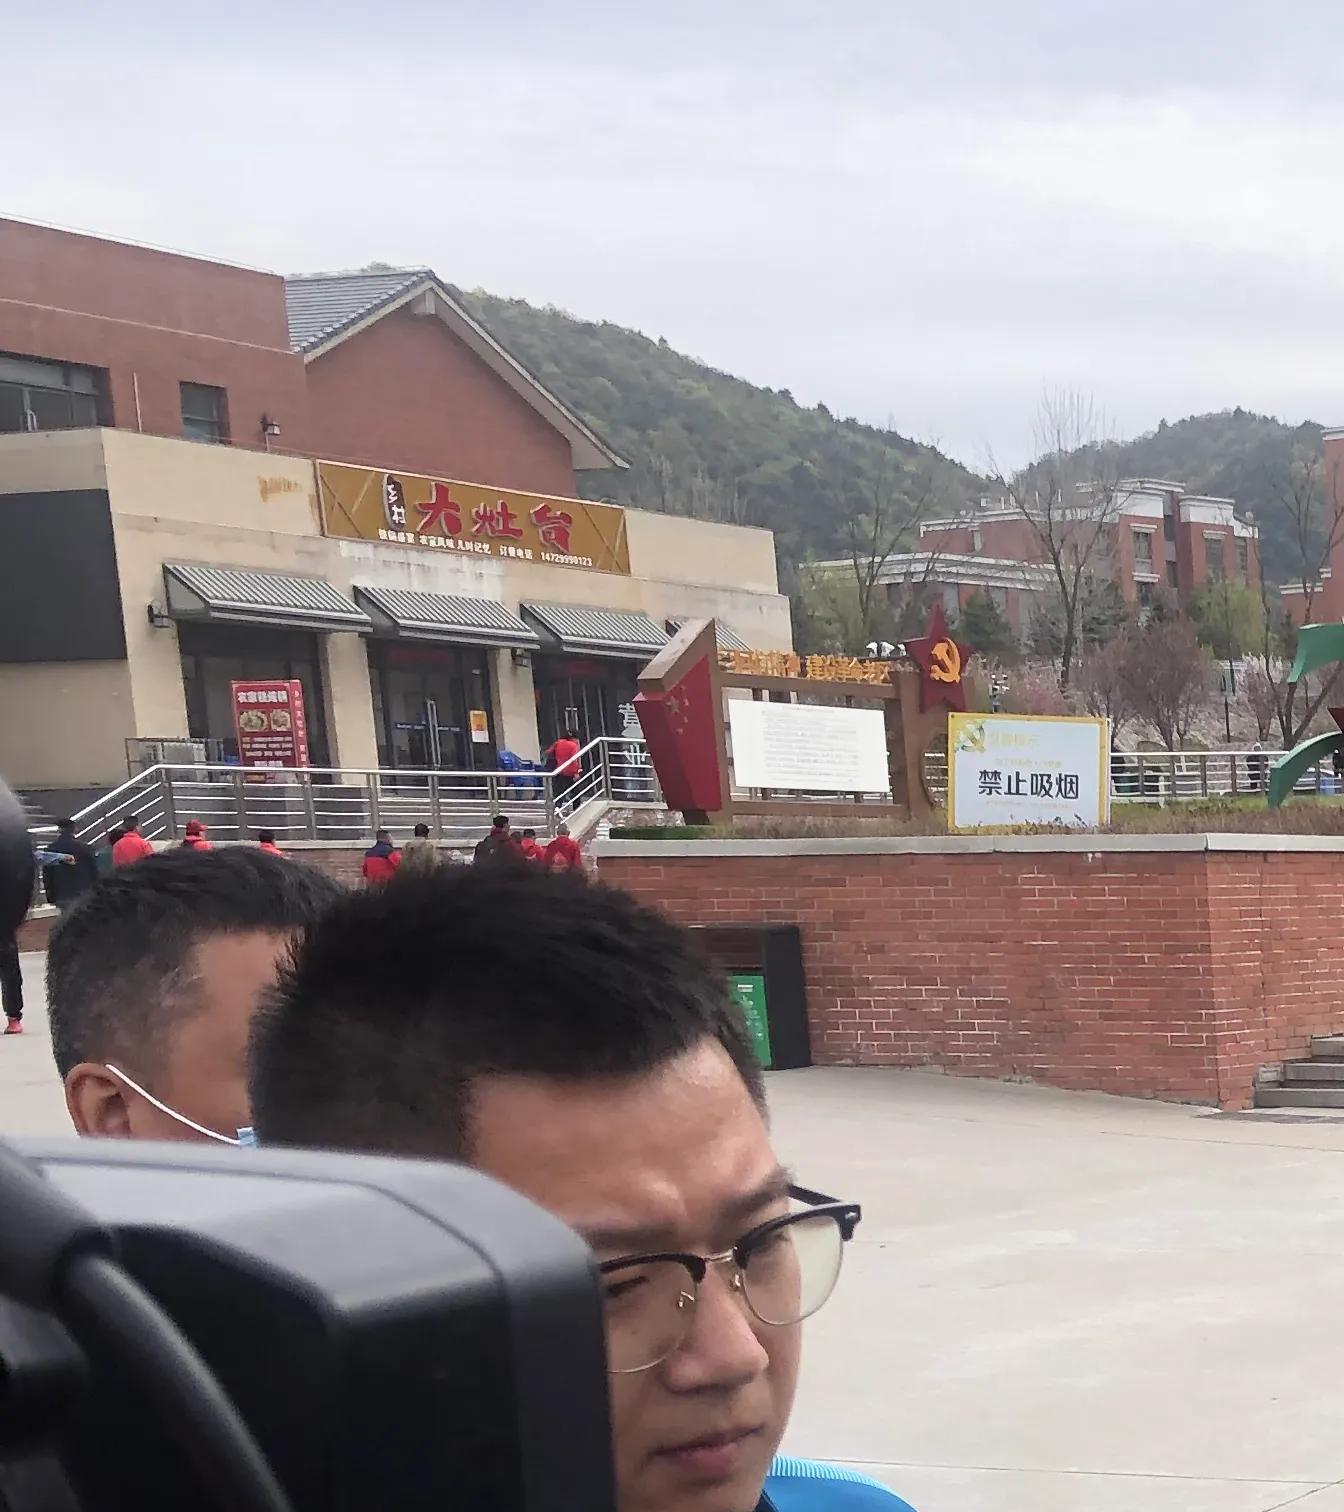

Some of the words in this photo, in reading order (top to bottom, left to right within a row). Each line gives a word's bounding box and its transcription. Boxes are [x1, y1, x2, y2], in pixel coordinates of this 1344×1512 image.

[416, 481, 574, 552] 大灶台
[978, 769, 1079, 800] 禁止吸烟
